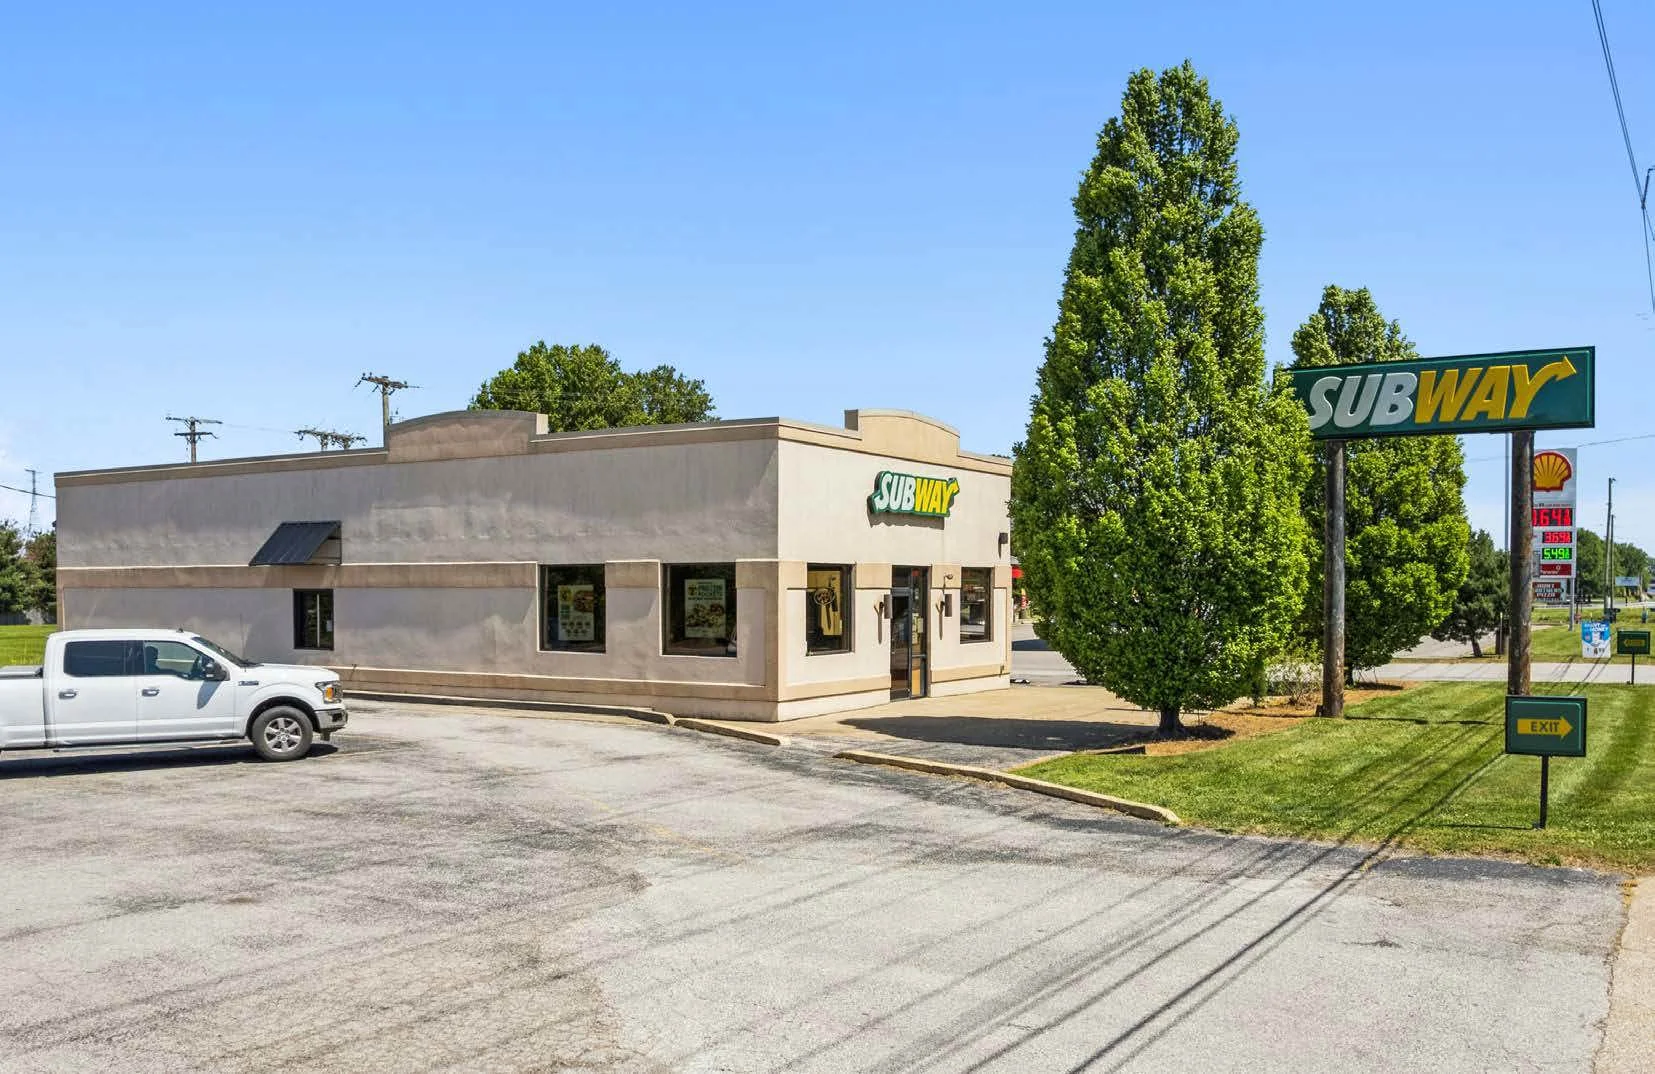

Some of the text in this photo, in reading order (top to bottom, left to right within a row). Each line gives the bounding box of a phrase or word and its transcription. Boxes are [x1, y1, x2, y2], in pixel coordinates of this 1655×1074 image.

[1309, 355, 1577, 430] SUBWAY
[874, 472, 960, 514] SUBWAY
[1530, 721, 1560, 733] EXIT
